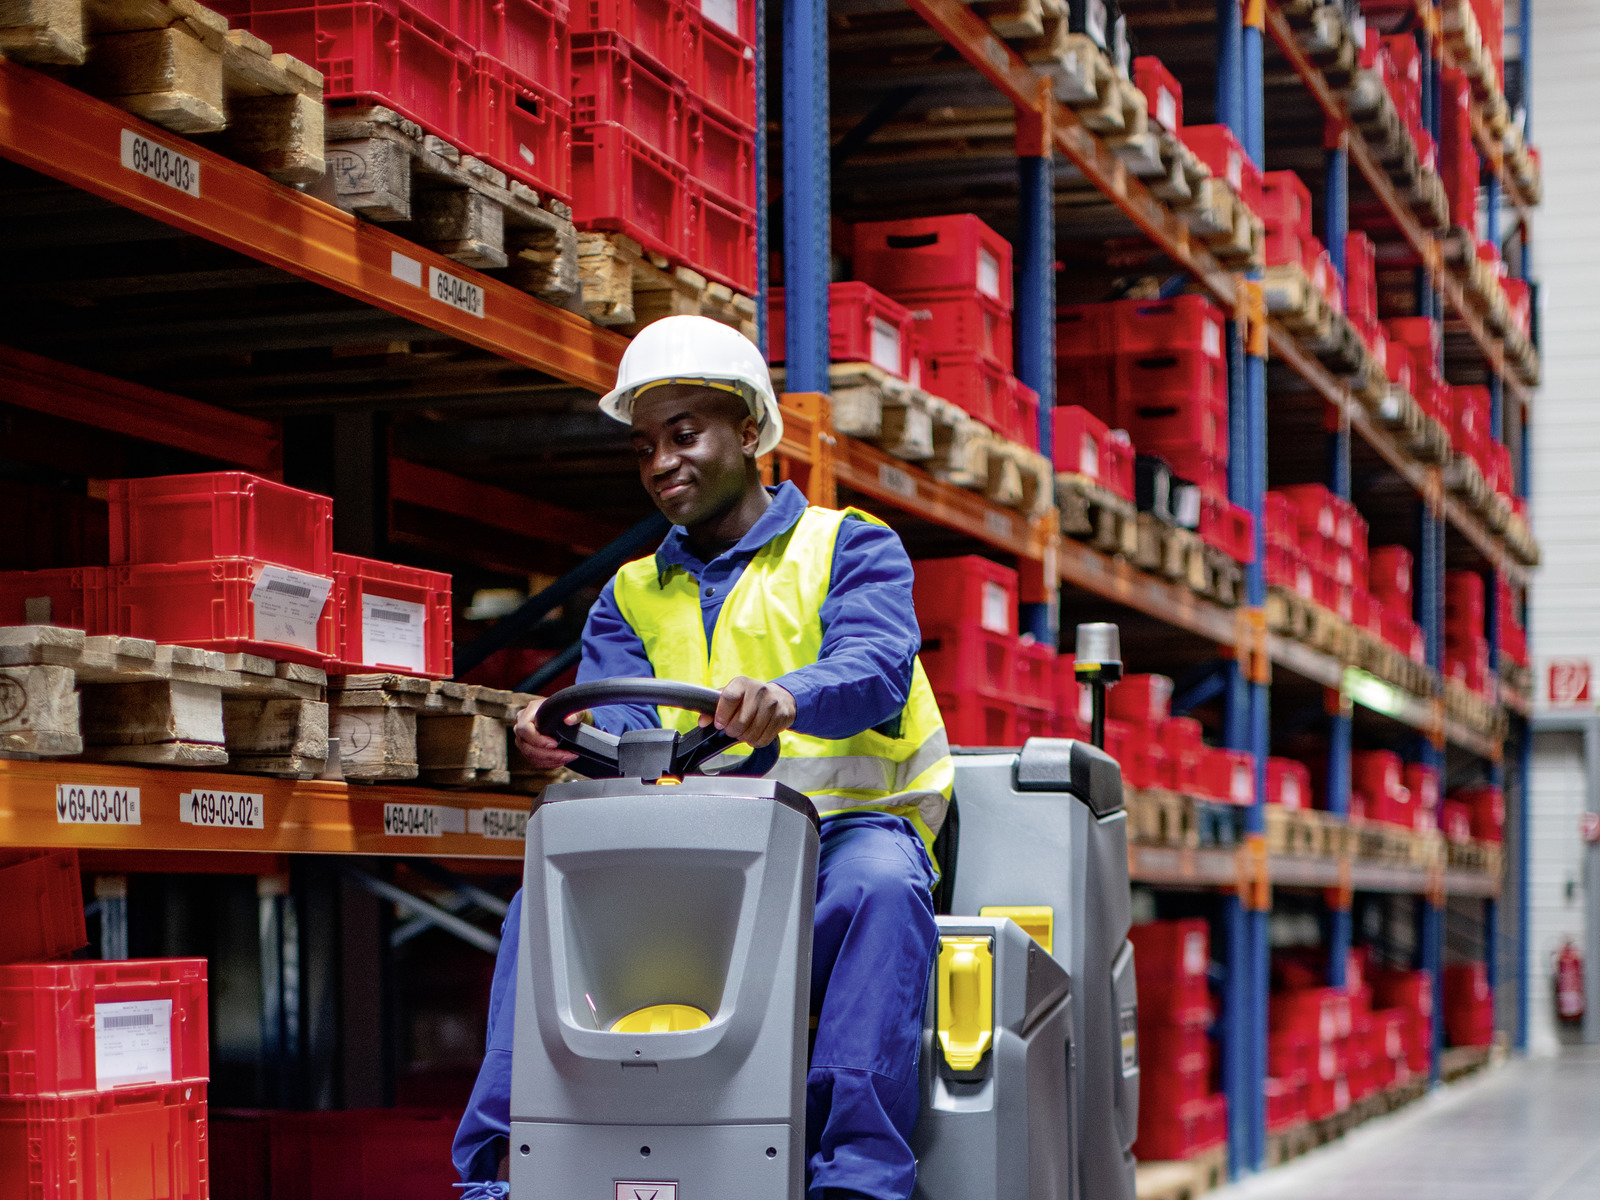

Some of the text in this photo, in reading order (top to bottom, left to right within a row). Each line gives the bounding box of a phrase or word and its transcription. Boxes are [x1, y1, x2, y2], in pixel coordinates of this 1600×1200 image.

[133, 138, 189, 190] 69-03-03
[437, 272, 476, 312] 69-04-03
[69, 788, 128, 822] 69-03-01
[201, 793, 253, 826] 69-03-02
[392, 806, 434, 834] 69-04-01
